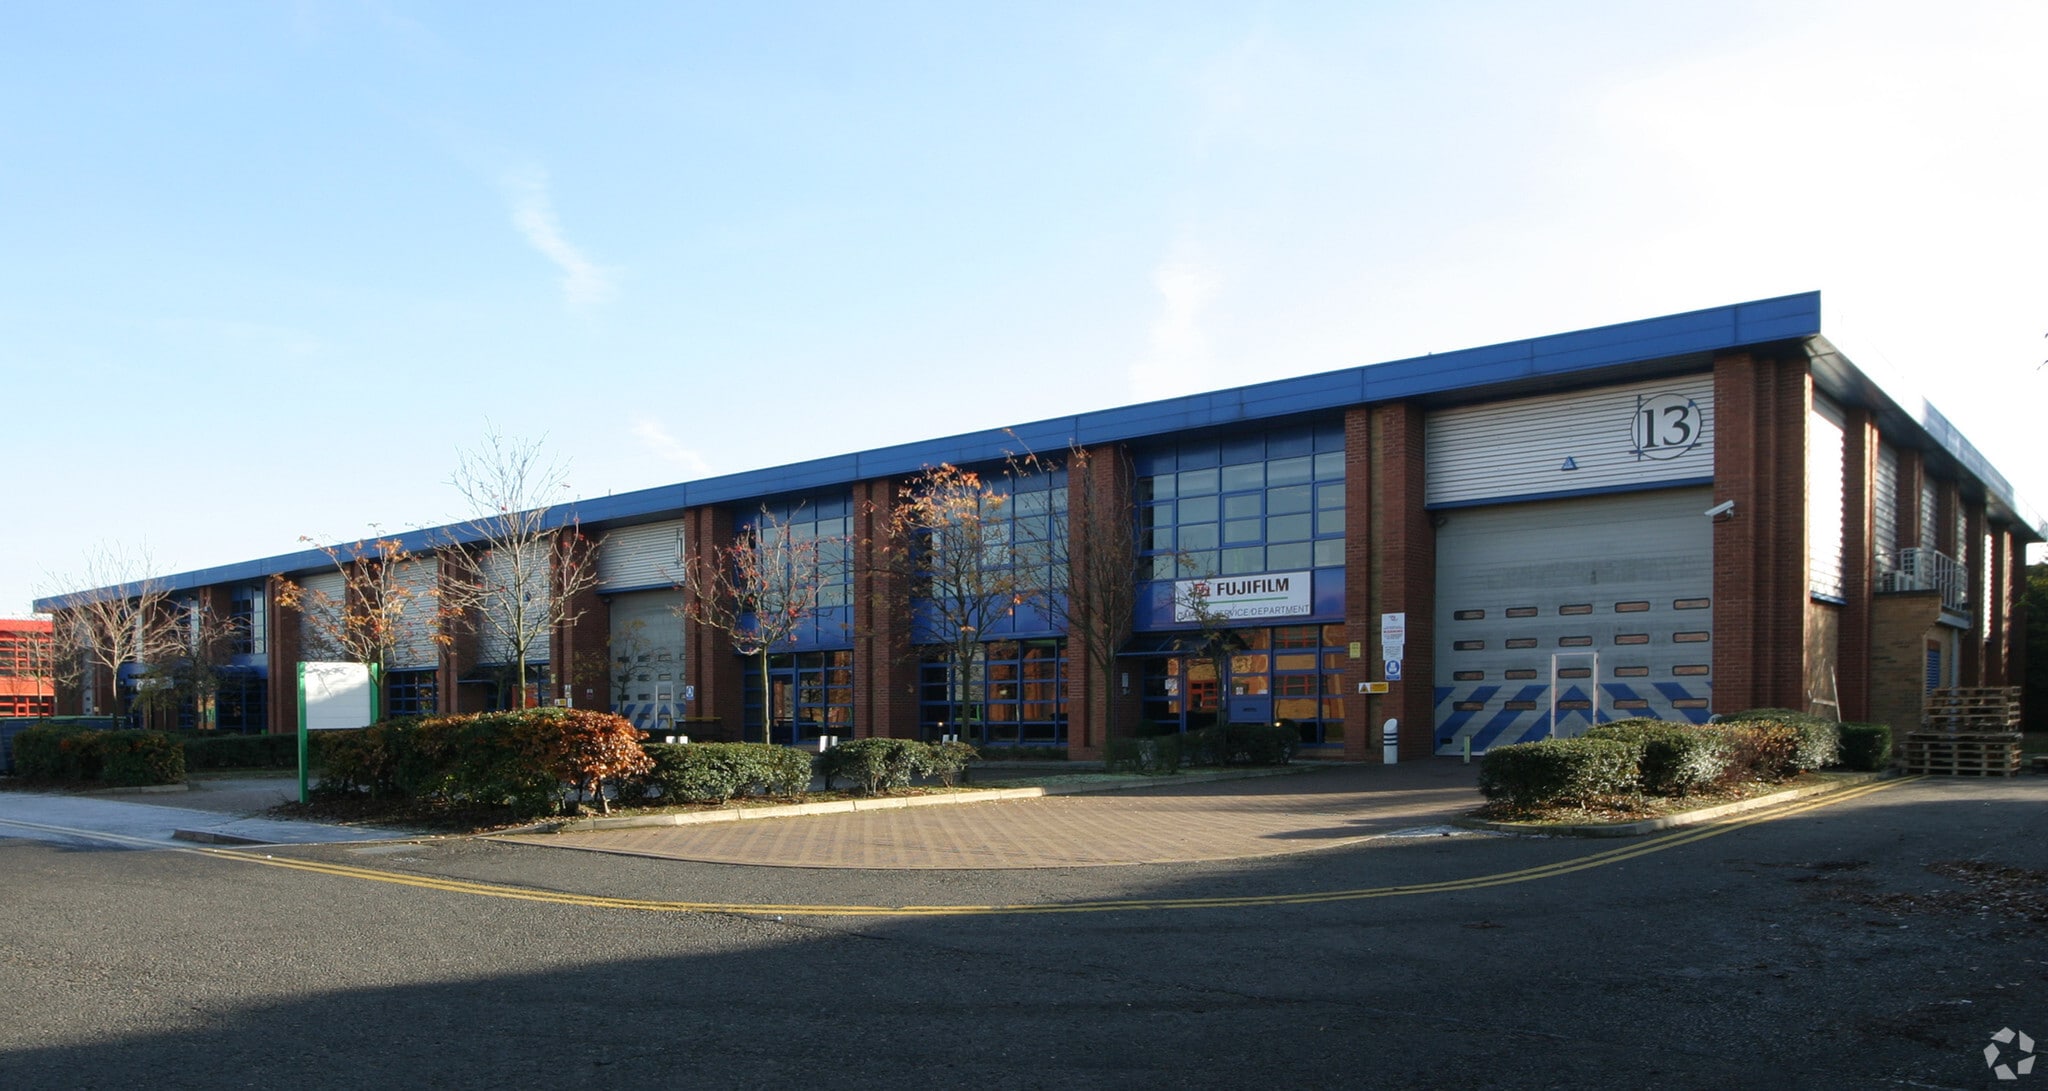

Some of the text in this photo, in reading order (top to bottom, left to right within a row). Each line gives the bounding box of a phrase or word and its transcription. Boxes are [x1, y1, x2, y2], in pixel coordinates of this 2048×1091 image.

[1642, 406, 1690, 448] 13
[1217, 578, 1289, 596] FUJIFILM
[1251, 604, 1309, 615] DEPARTMENT
